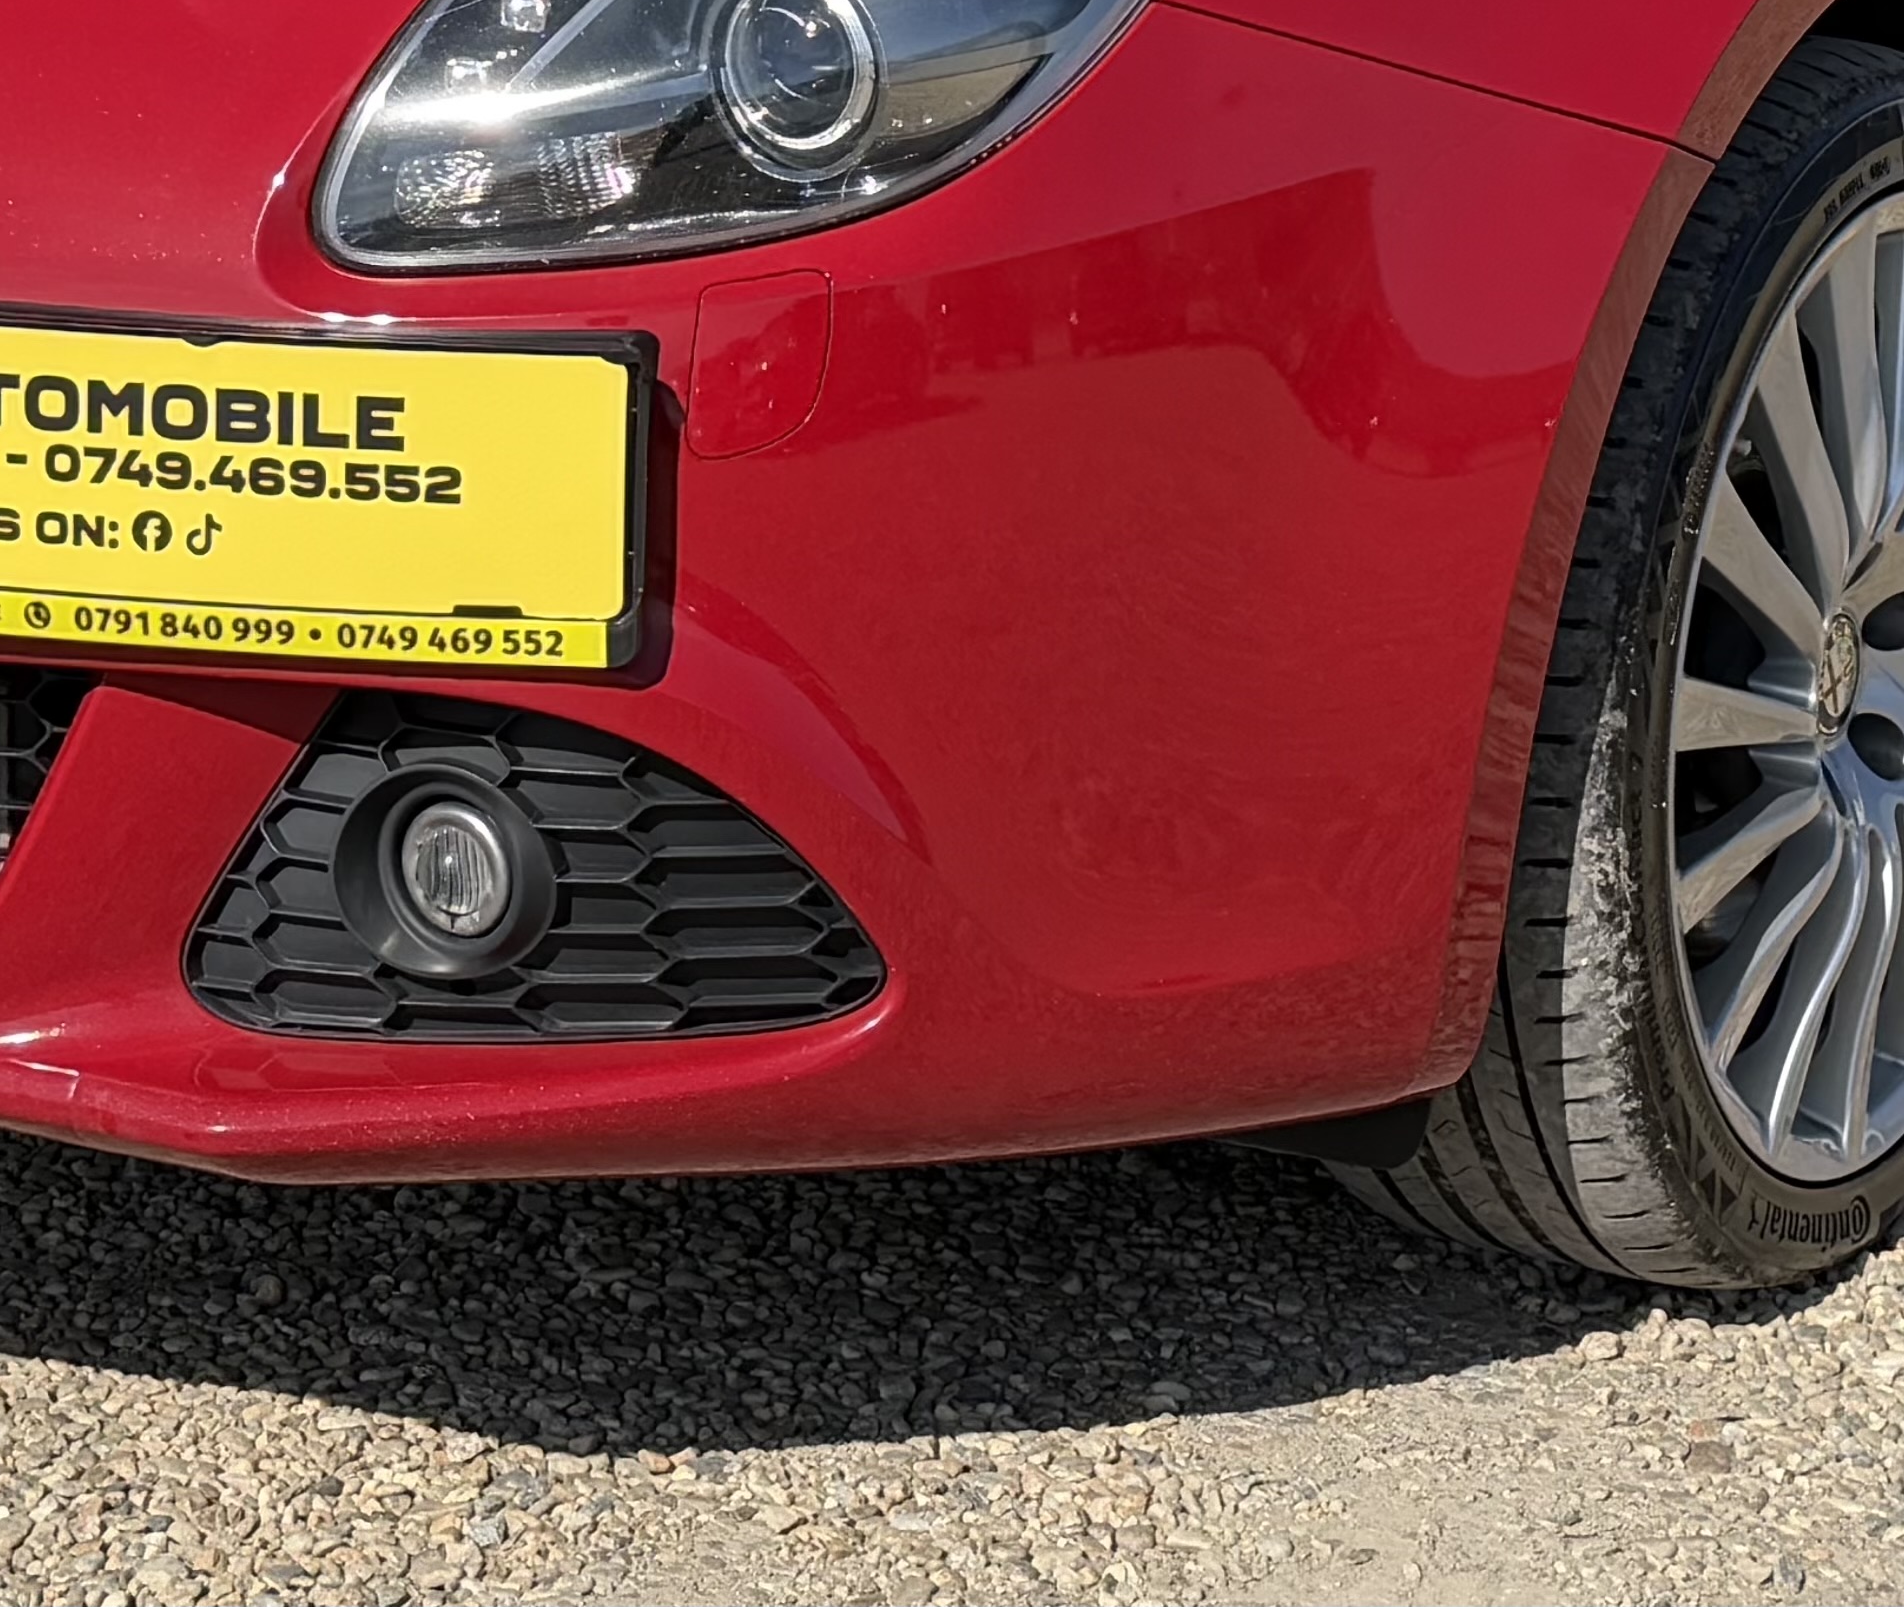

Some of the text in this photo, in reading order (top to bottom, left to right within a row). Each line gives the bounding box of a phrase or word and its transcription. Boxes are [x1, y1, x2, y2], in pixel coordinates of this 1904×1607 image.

[44, 443, 463, 505] 0749.469.552
[35, 510, 120, 550] ON:
[73, 606, 564, 658] 0791 840 999 0749 469 552
[1759, 1194, 1871, 1253] Continental
